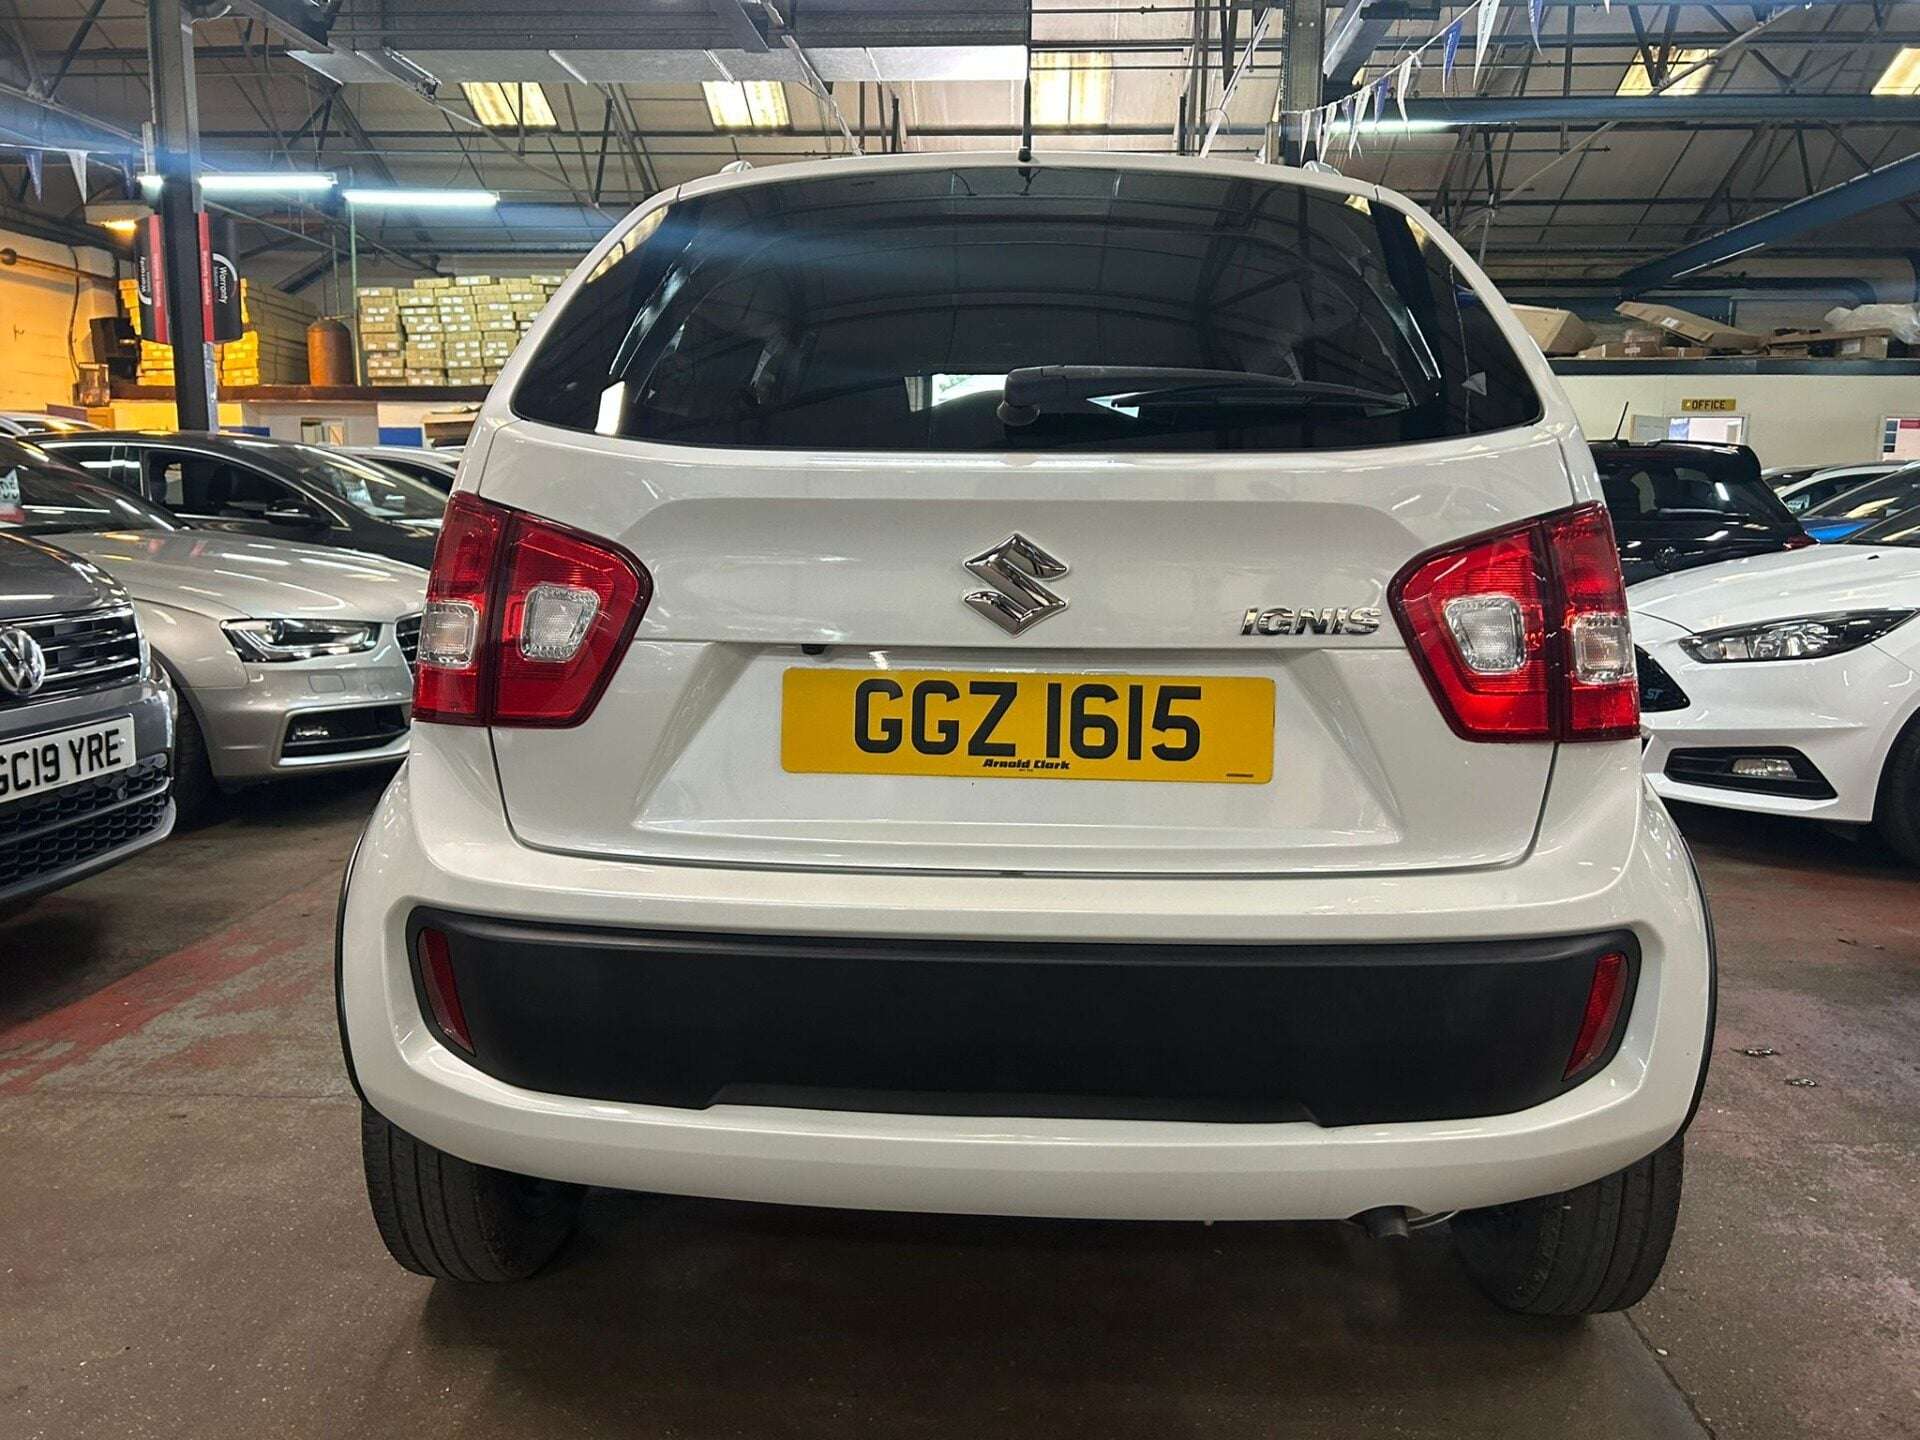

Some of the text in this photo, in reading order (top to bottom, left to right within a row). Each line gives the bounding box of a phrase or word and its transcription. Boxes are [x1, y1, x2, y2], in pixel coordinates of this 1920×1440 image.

[218, 266, 229, 305] Warranty
[1691, 399, 1726, 410] OFFICE
[1241, 607, 1382, 636] IGNIS
[1644, 688, 1664, 700] ST
[854, 678, 1202, 761] GGZ 1615
[68, 728, 121, 775] YRE
[983, 758, 1071, 770] Arnold Clark
